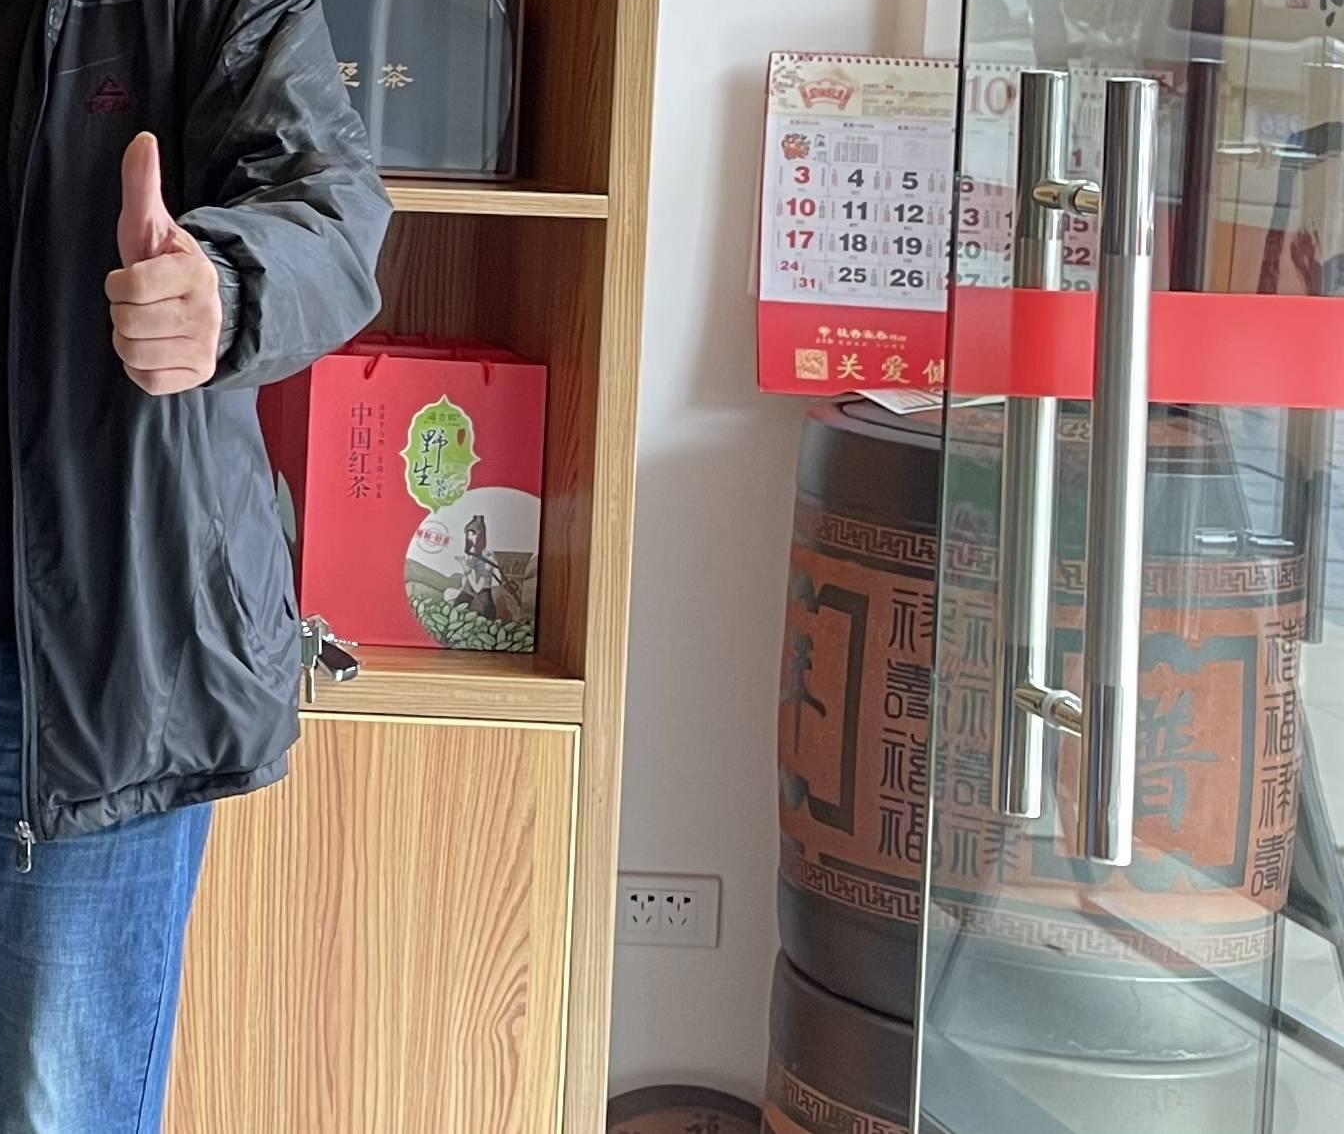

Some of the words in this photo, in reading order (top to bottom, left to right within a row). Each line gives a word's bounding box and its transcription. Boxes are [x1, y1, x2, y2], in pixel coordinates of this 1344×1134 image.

[966, 75, 1012, 116] 10
[794, 165, 811, 185] 3
[847, 168, 865, 188] 4
[901, 171, 919, 190] 5
[785, 197, 816, 217] 10
[842, 200, 869, 221] 11
[894, 203, 924, 224] 12
[785, 229, 814, 250] 17
[838, 232, 868, 253] 18
[892, 235, 923, 256] 19
[780, 260, 799, 272] 24
[838, 266, 867, 284] 25
[889, 268, 924, 289] 26
[798, 277, 816, 289] 31
[346, 402, 373, 499] 中国红茶
